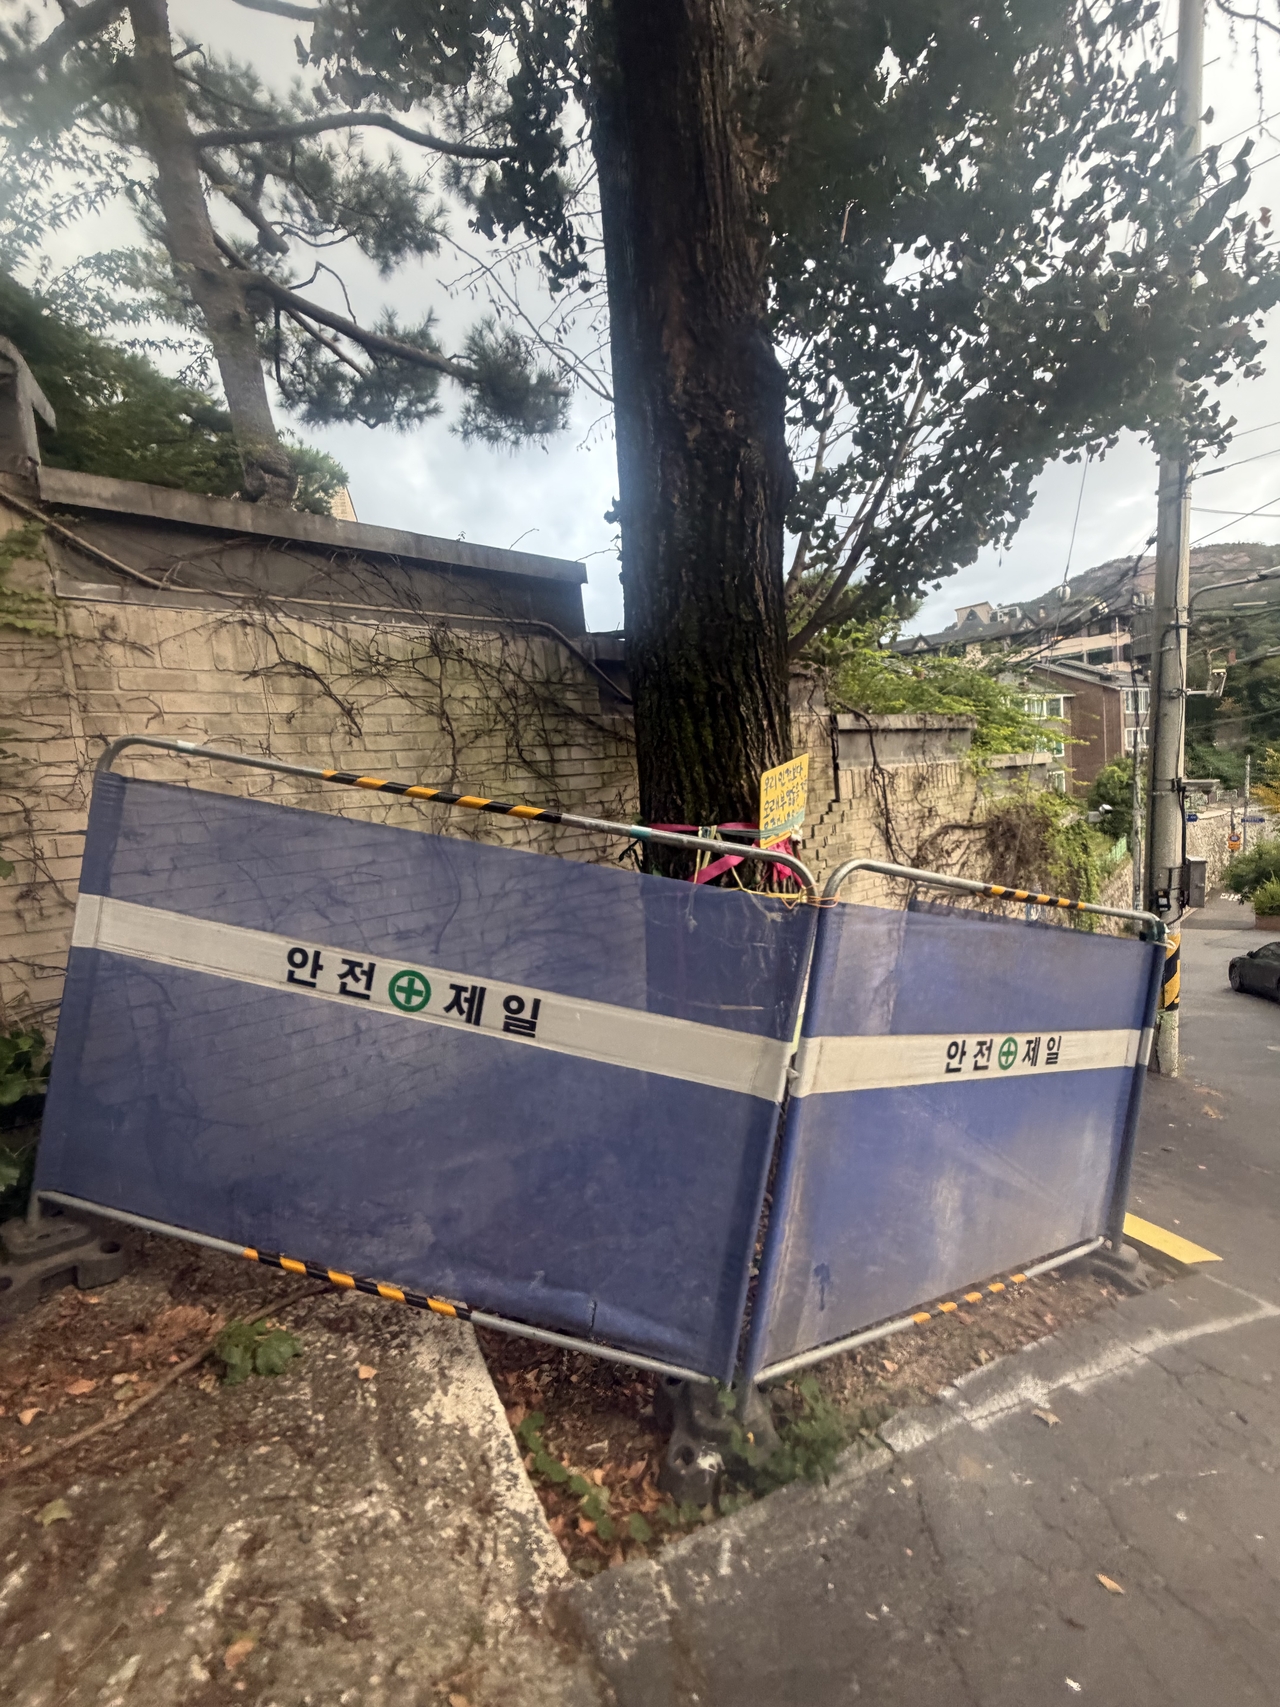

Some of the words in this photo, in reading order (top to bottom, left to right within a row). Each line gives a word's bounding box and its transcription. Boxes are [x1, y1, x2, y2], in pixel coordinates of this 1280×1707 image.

[764, 774, 778, 797] 우리
[763, 794, 780, 819] 오래
[286, 947, 376, 1000] 안전
[443, 983, 542, 1038] 제일
[944, 1038, 994, 1074] 안전
[1021, 1035, 1062, 1067] 제일
